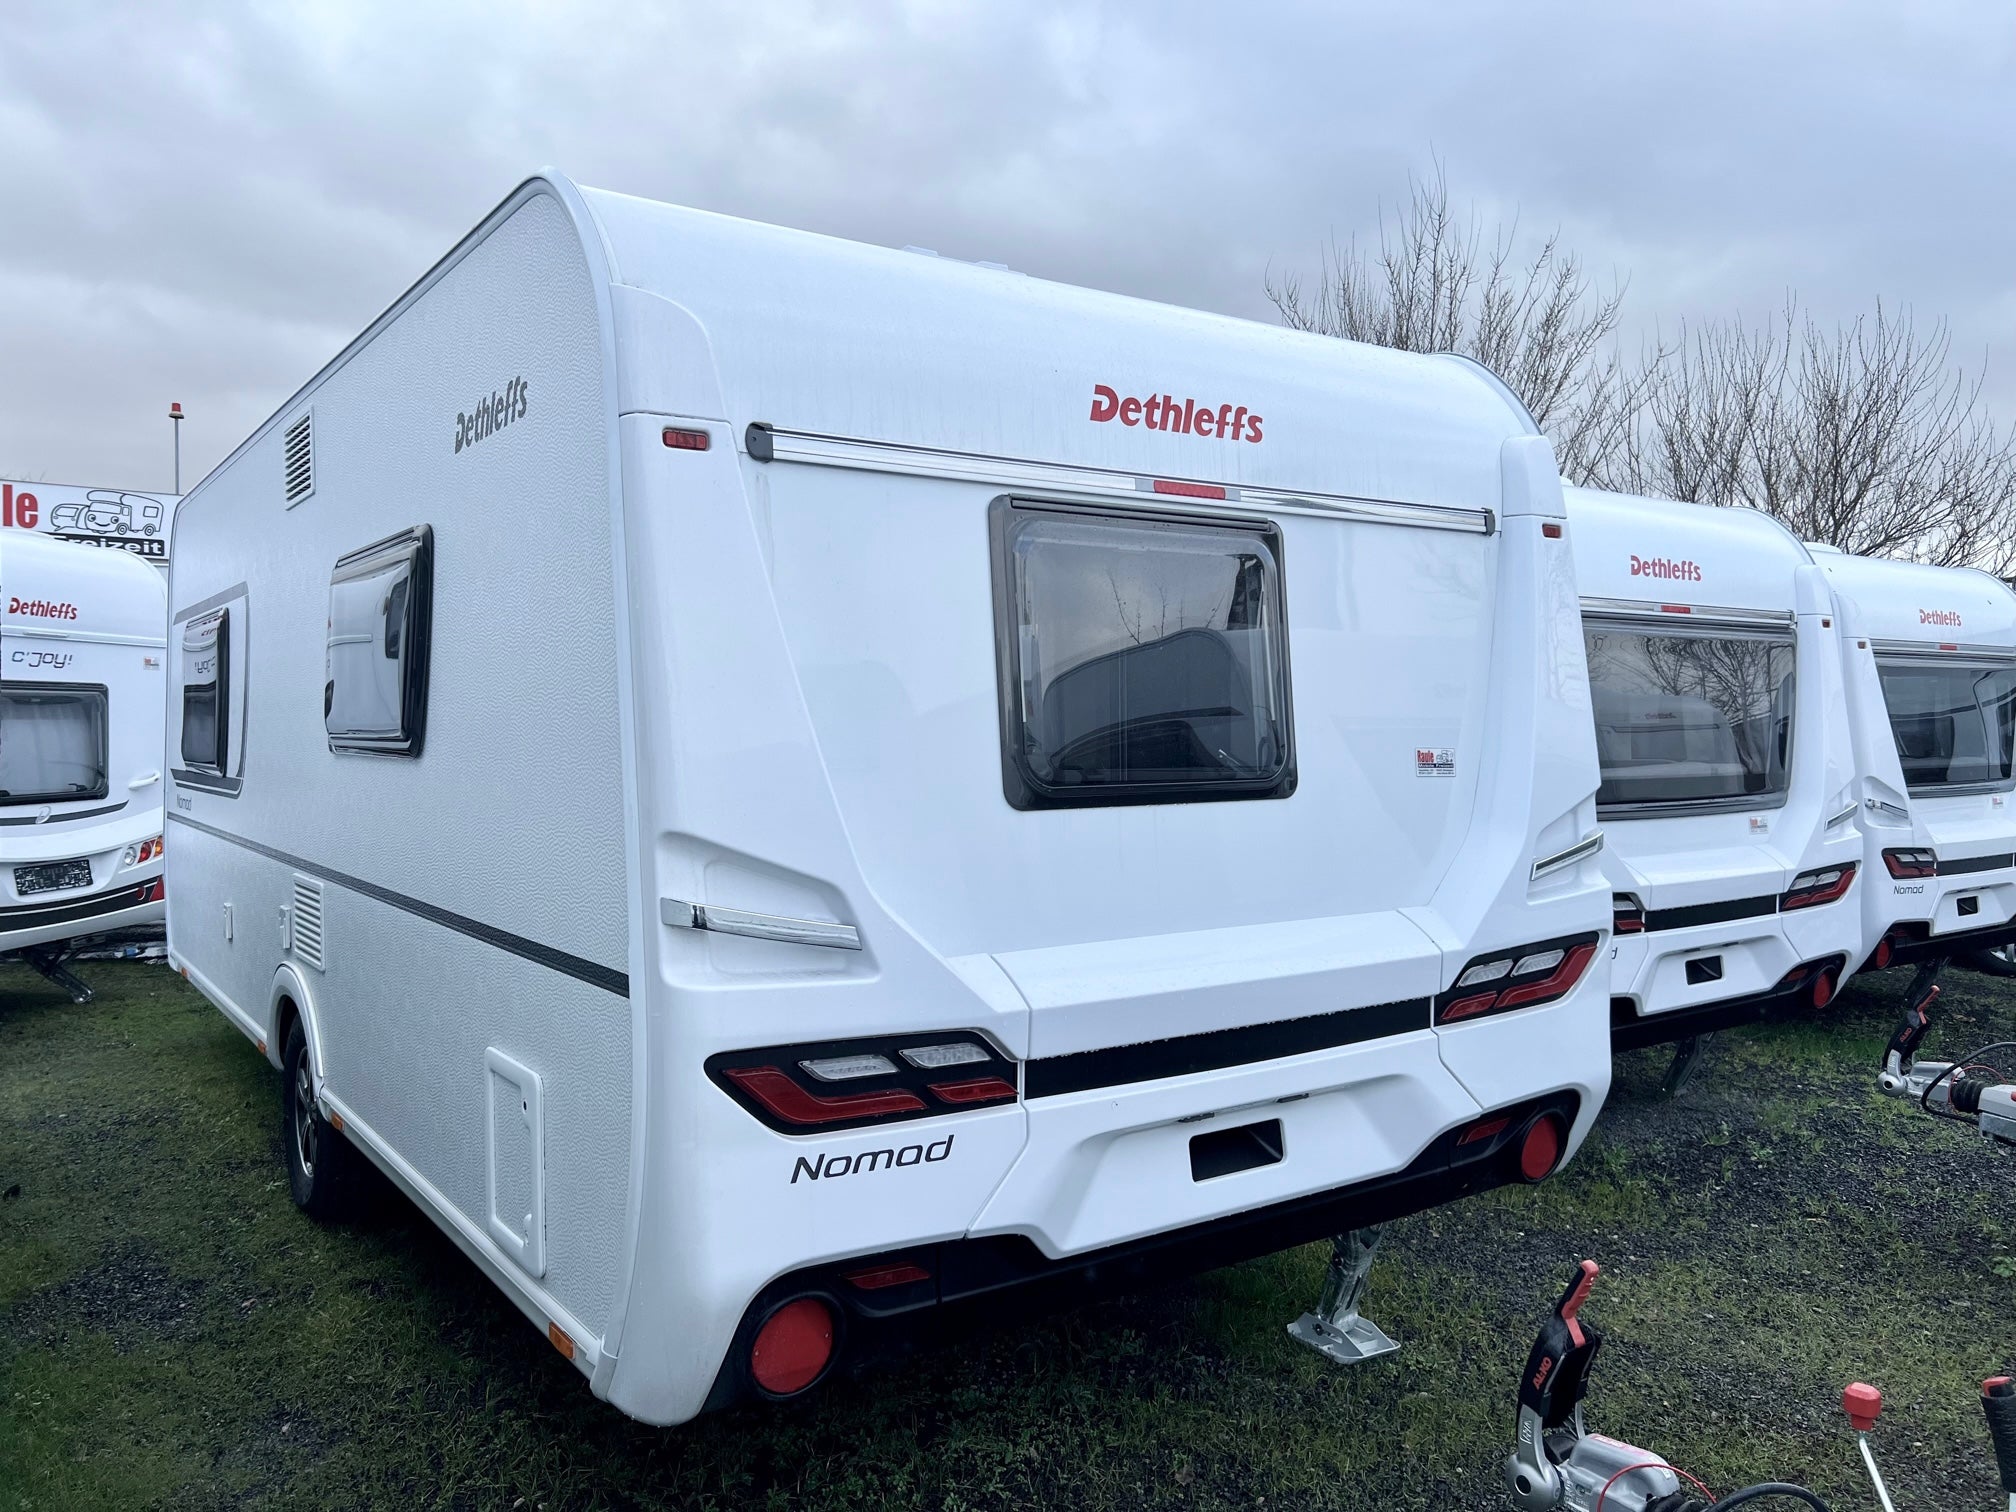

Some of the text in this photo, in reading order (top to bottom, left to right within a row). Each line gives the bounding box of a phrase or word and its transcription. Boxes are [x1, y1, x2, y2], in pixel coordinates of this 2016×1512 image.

[455, 375, 528, 455] Dethleffs
[1089, 384, 1263, 444] Dethleffs
[1630, 555, 1702, 582] Dethleffs
[8, 597, 78, 620] Dethleffs
[1919, 608, 1962, 627] Dethleffs
[1893, 884, 1925, 895] Nomad
[790, 1134, 955, 1185] Nomad
